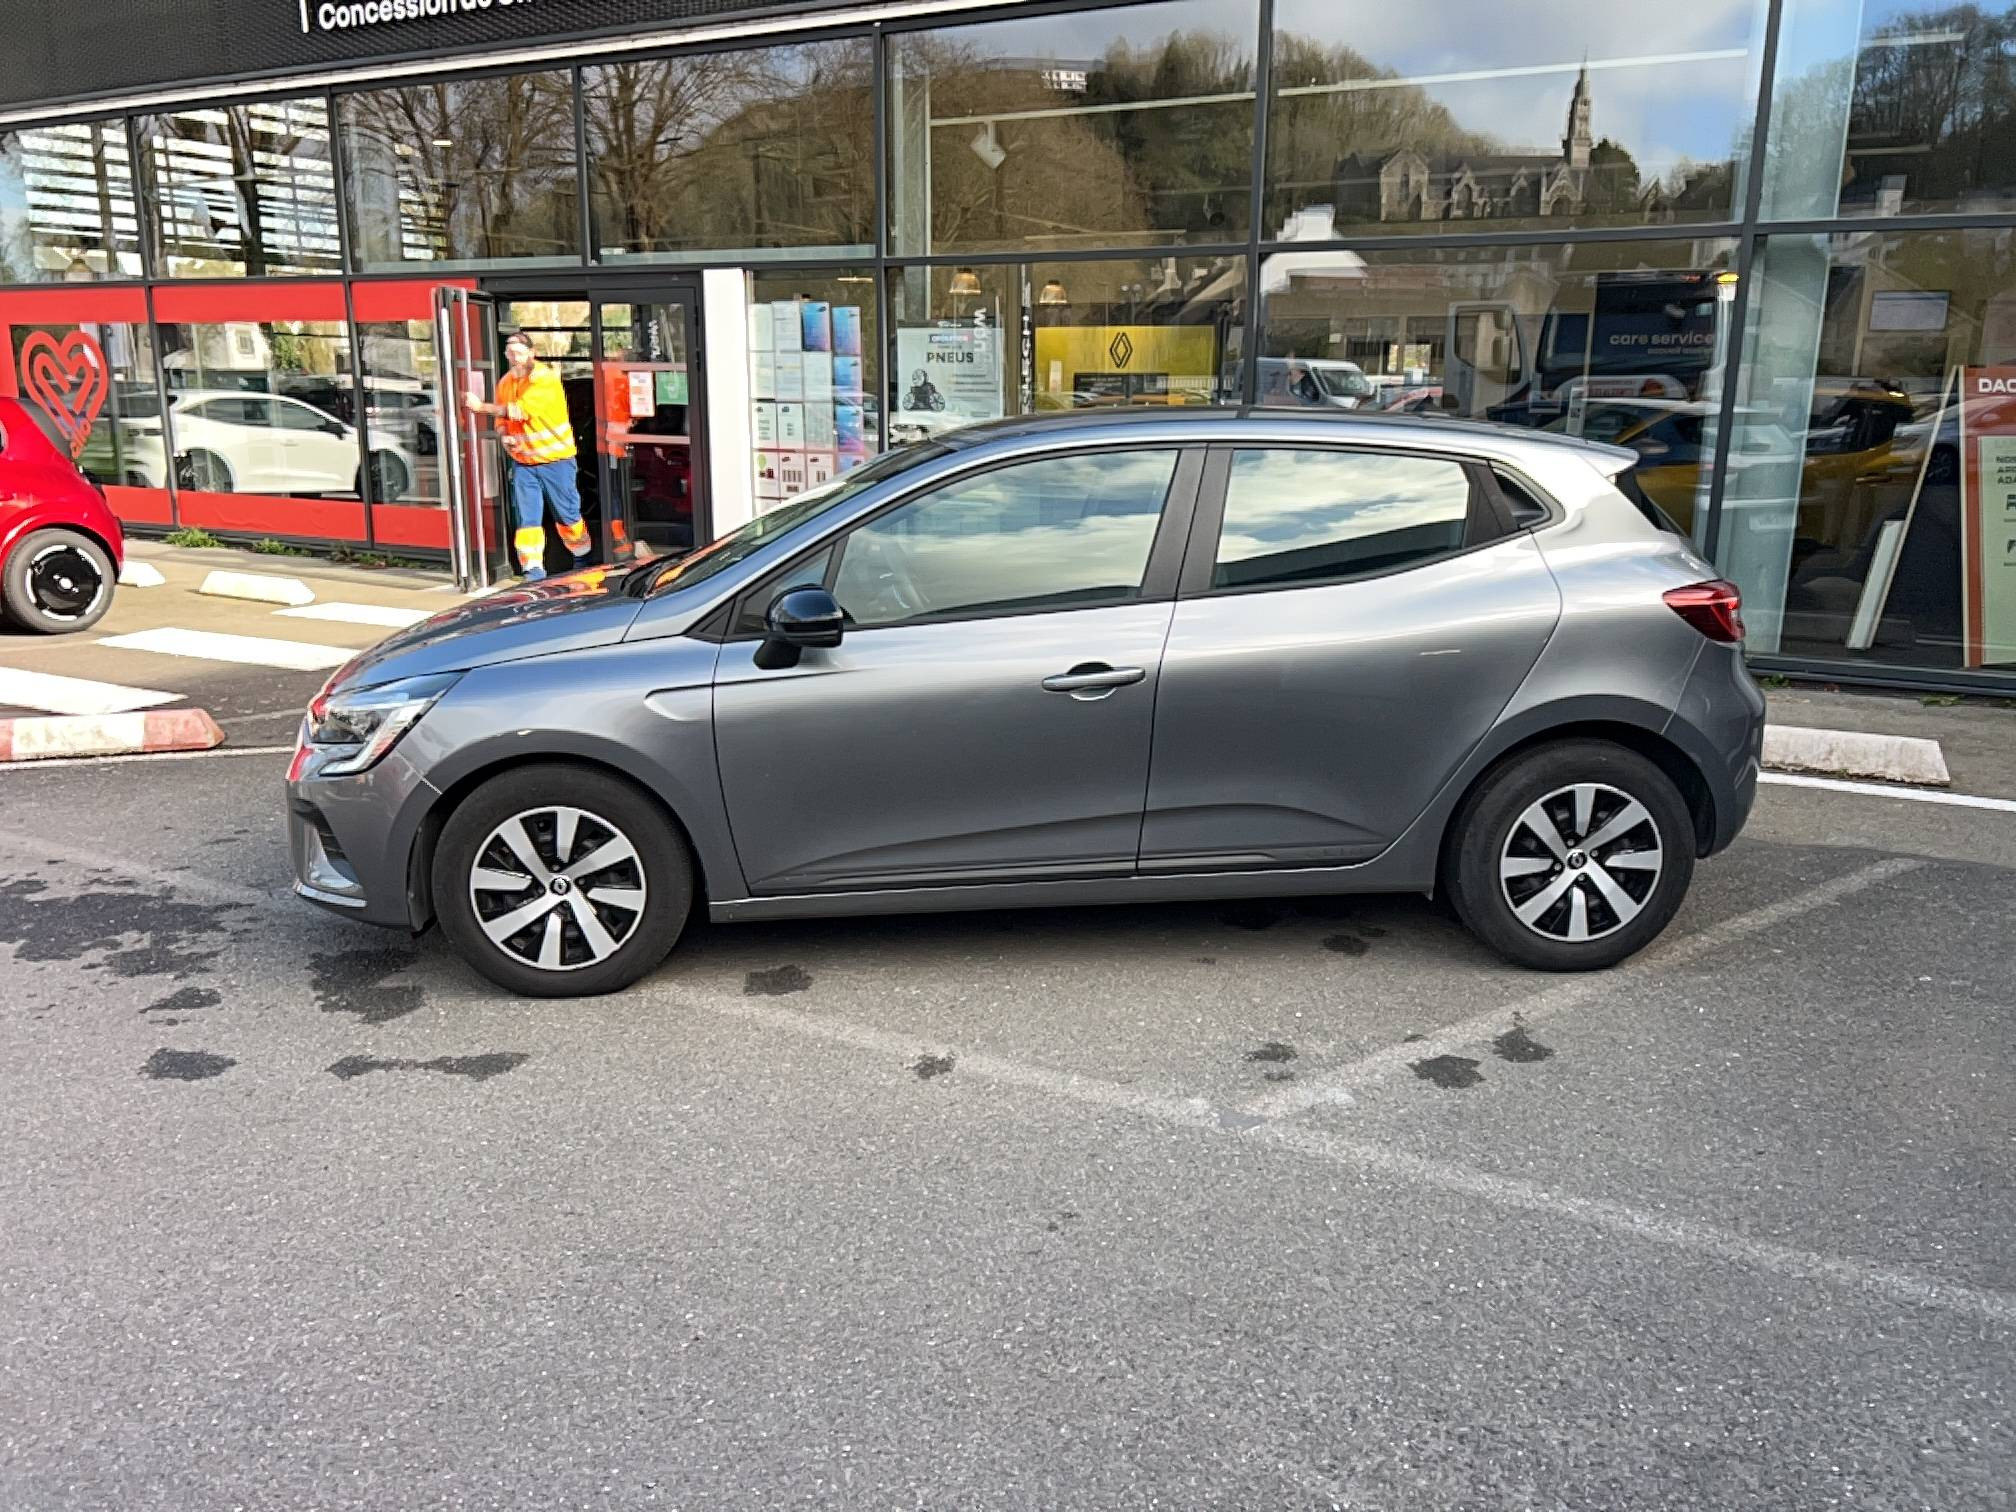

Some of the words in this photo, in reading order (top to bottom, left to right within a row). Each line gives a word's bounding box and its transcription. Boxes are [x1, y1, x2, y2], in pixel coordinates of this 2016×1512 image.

[318, 0, 457, 30] Concession
[1609, 333, 1649, 345] care
[1651, 331, 1715, 345] service
[926, 351, 974, 363] PNEUS
